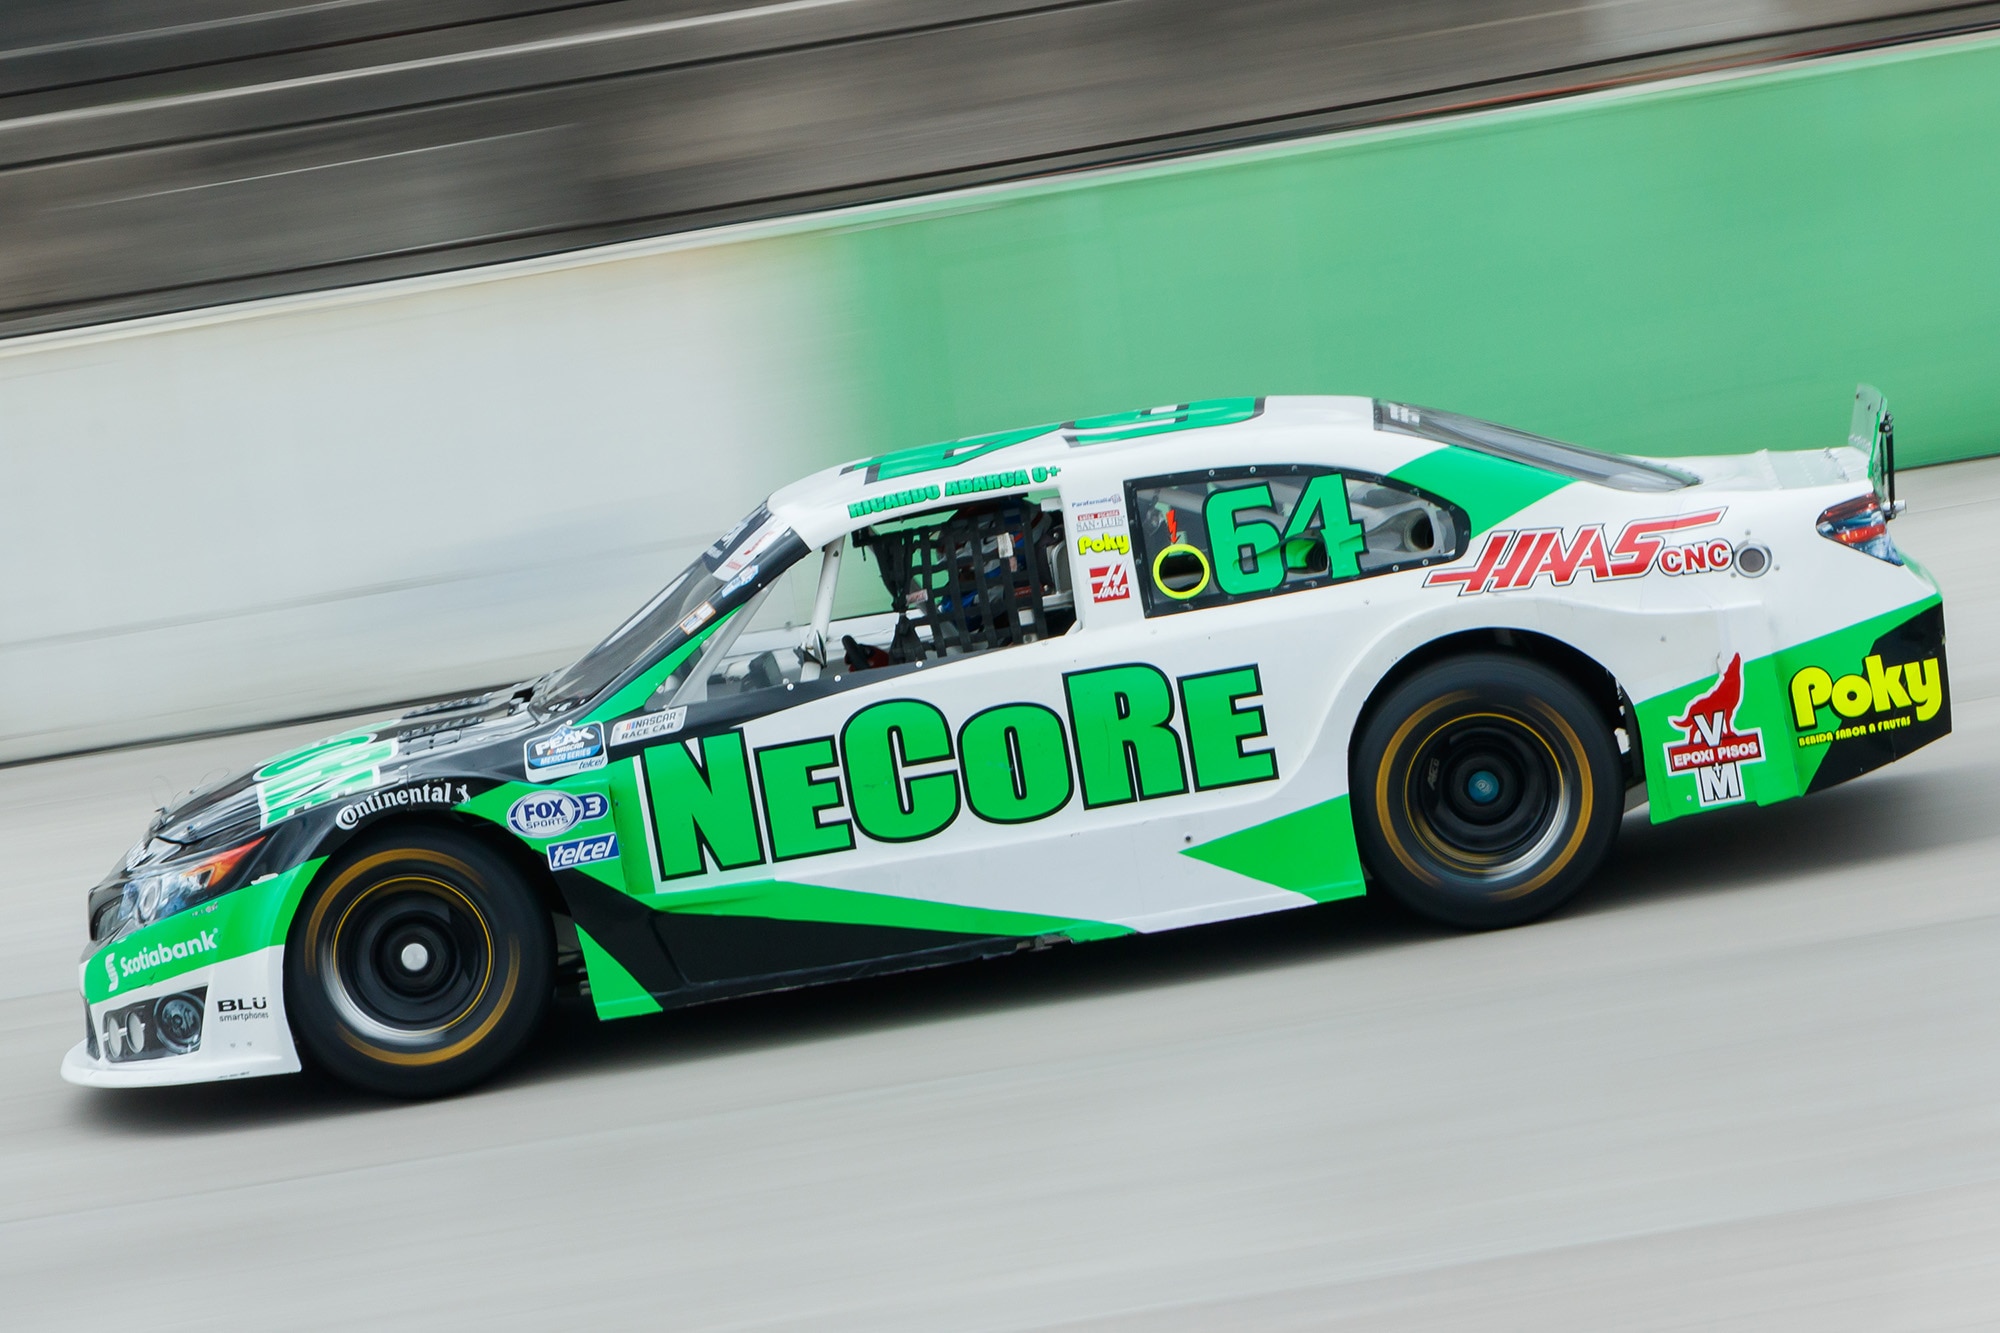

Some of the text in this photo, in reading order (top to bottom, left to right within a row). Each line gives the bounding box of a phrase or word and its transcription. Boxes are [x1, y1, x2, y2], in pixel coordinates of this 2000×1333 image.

[847, 484, 941, 519] RICARDO
[945, 468, 1031, 497] ABARCA
[1078, 532, 1131, 556] Poky
[1202, 472, 1370, 597] 64
[1422, 506, 1734, 596] HAAS CNC
[1788, 653, 1943, 732] Poky
[621, 722, 674, 740] RACE CAR
[634, 712, 677, 728] NASCAR
[1692, 709, 1725, 748] V
[1798, 715, 1911, 747] BEBIDA SABOR A FRUTAS
[535, 726, 596, 756] PEAK
[1673, 741, 1759, 768] EPOXI PISOS
[578, 757, 605, 770] telcel
[1699, 761, 1742, 803] M
[336, 782, 452, 831] Continental
[524, 796, 602, 821] FOX 3
[526, 816, 569, 829] SPORTS
[552, 835, 615, 867] telcel
[120, 929, 218, 978] Scotiabank
[219, 1011, 270, 1023] smartphones
